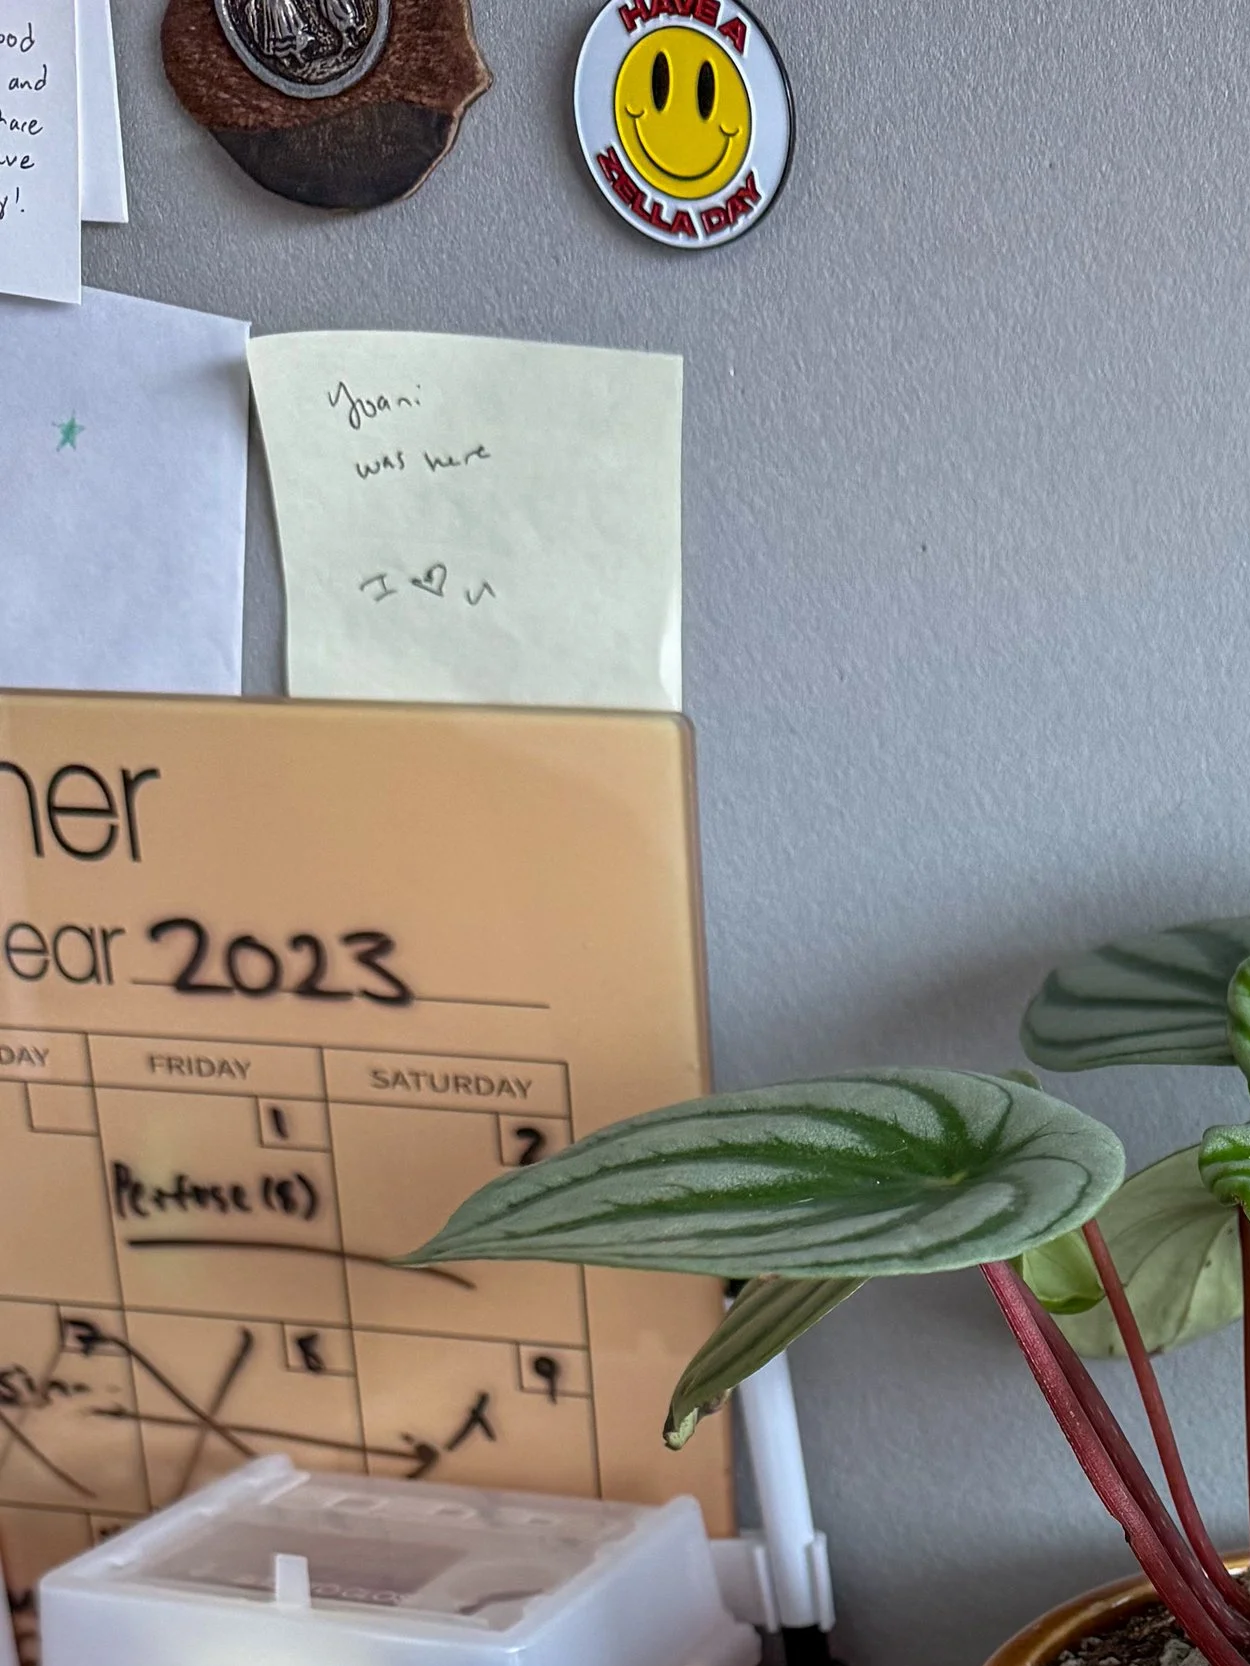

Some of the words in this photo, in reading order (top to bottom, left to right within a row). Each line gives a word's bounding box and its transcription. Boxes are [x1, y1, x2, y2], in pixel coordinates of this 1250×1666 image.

[718, 16, 748, 56] A
[8, 64, 48, 91] and
[596, 145, 698, 238] ZELLA
[701, 170, 762, 234] DAY
[356, 451, 405, 479] was
[424, 444, 491, 472] here
[359, 573, 398, 602] I
[147, 917, 415, 1008] 2023
[148, 1052, 252, 1080] FRIDAY
[369, 1069, 533, 1100] SATURDAY
